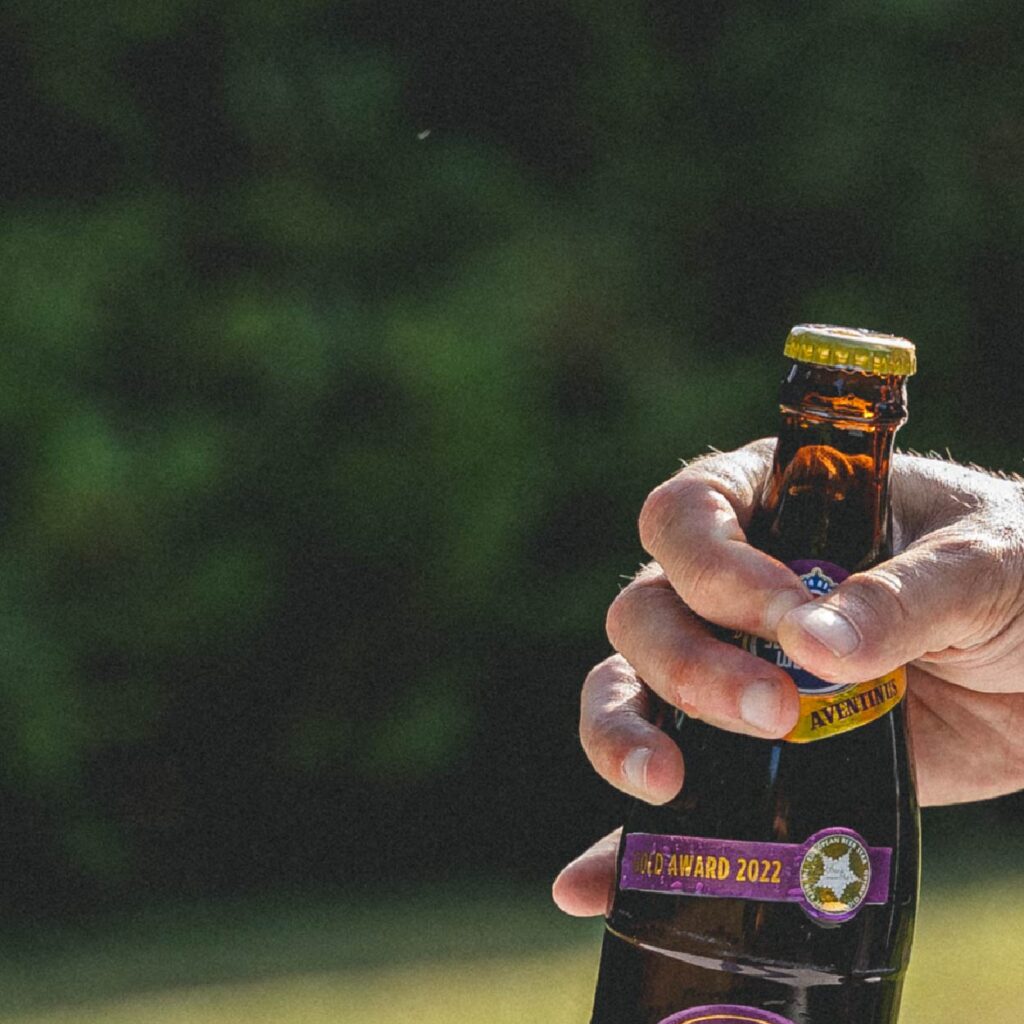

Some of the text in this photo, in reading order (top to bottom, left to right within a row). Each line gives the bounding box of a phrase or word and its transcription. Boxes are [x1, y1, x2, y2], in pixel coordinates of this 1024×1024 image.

[811, 679, 897, 731] AVENTINUS
[668, 854, 730, 880] AWARD
[736, 858, 781, 883] 2022
